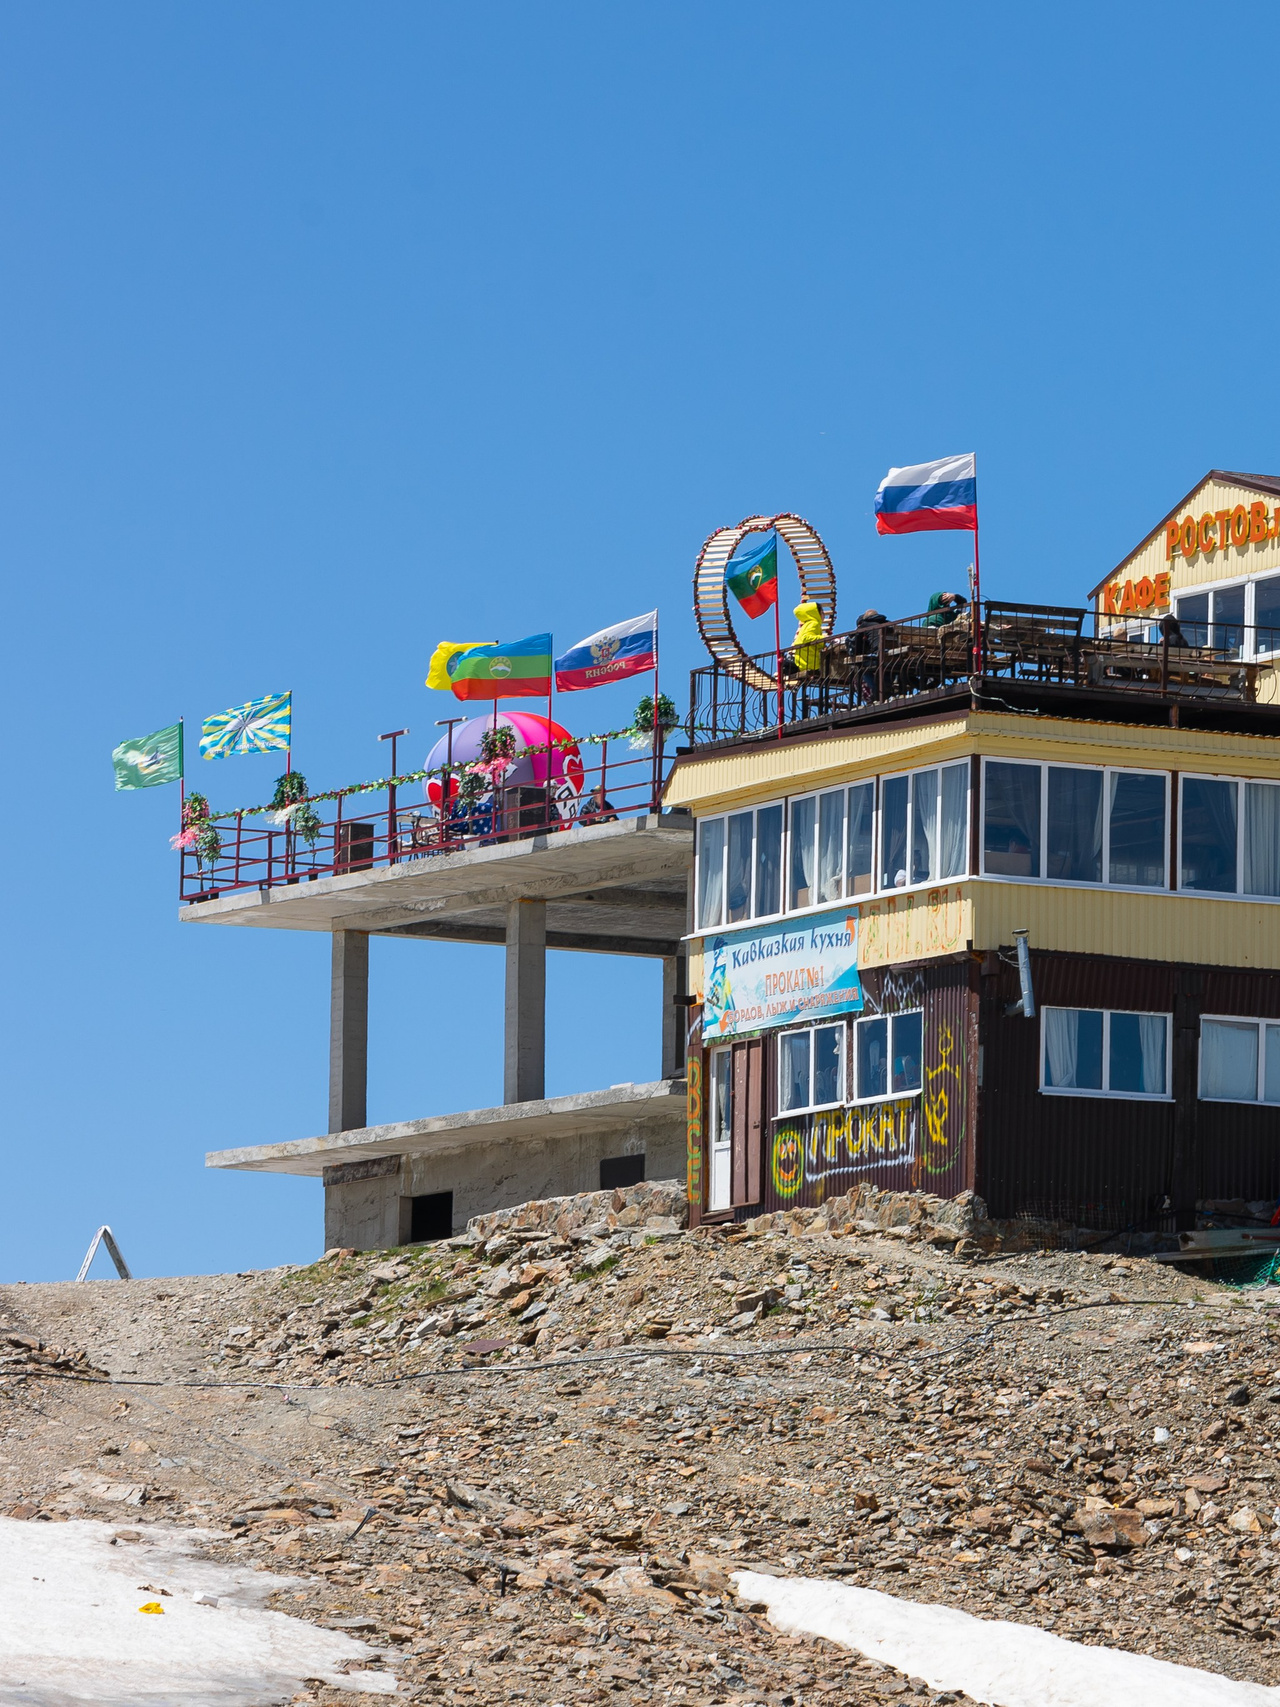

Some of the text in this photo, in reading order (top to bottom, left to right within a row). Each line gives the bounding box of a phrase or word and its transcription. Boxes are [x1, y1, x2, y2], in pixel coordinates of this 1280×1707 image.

[1103, 572, 1171, 618] КАФЕ
[810, 927, 852, 954] кухня
[765, 968, 805, 997] ПРОКАТ
[766, 1001, 788, 1017] ЛЫЖ
[797, 987, 860, 1011] СНАРЯЖЕНИЯ
[808, 1099, 912, 1163] ПРОКАТ
